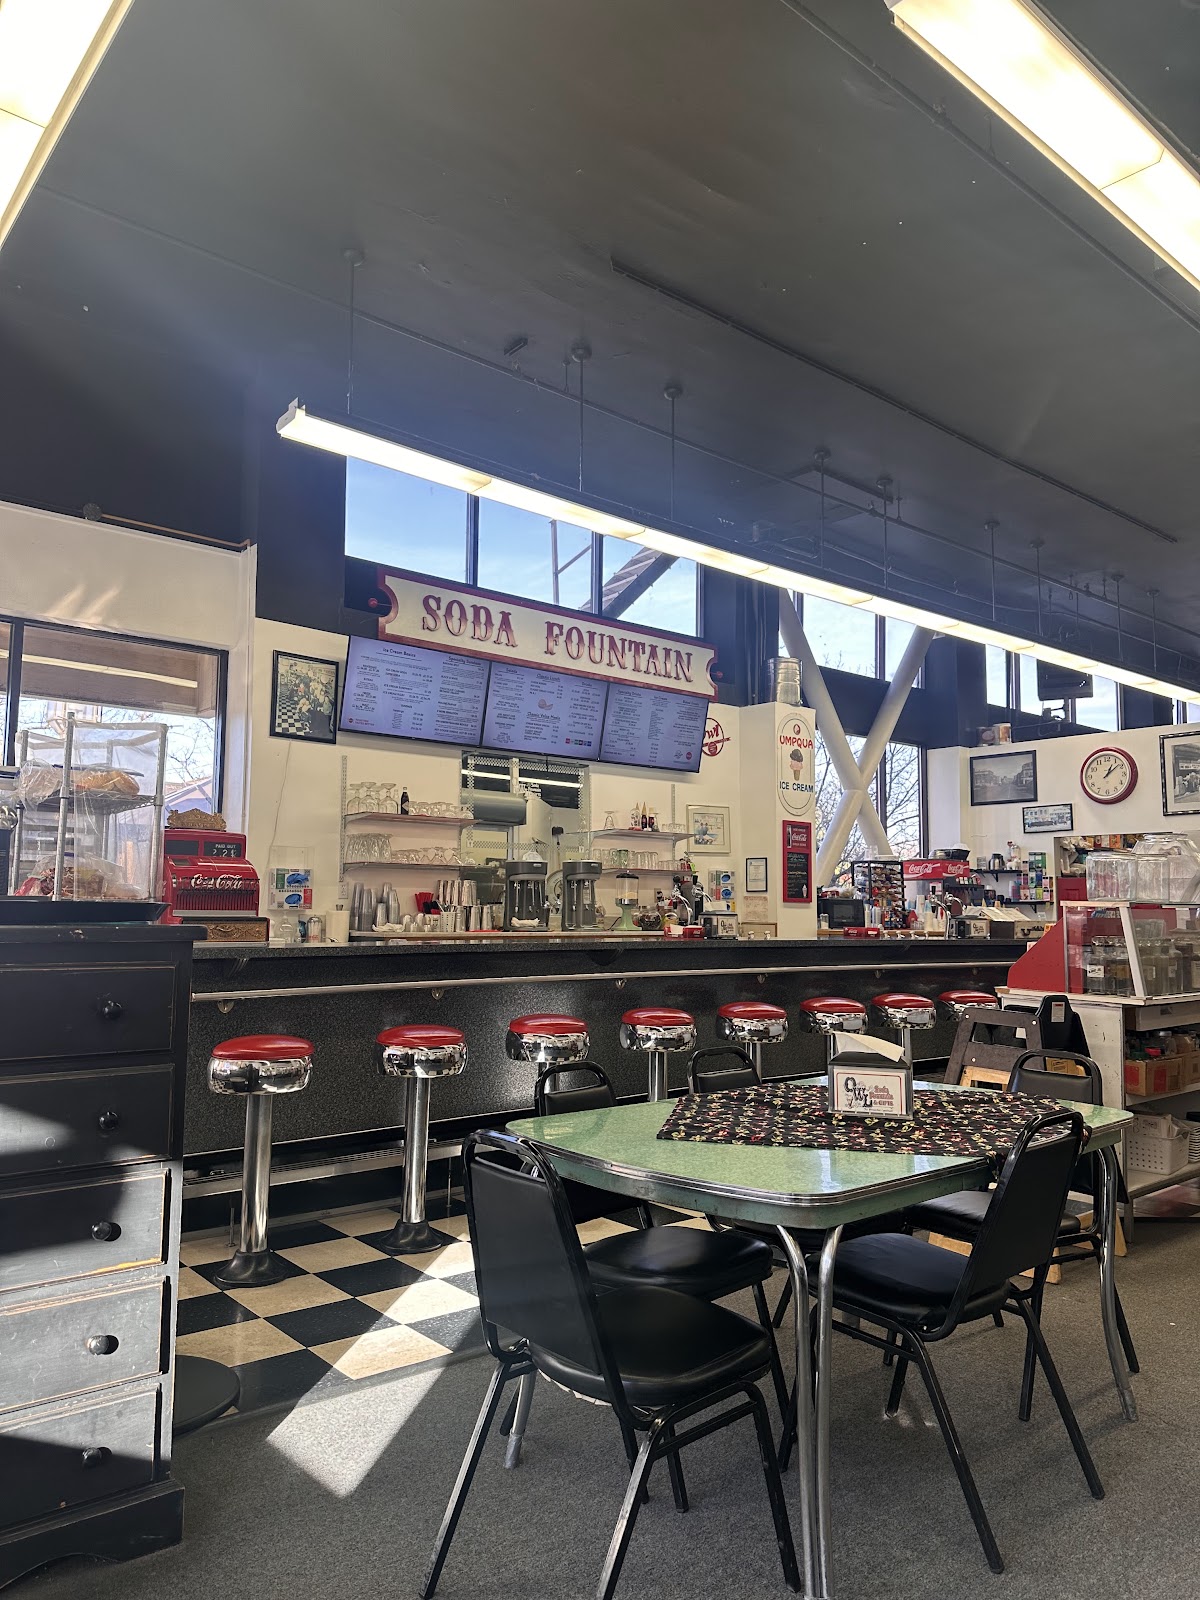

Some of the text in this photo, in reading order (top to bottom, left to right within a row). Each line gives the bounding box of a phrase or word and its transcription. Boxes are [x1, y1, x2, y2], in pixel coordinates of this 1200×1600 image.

[422, 594, 694, 683] SODA FOUNTAIN
[779, 735, 814, 750] UMPQUA
[779, 780, 814, 793] ICE CREAM
[908, 863, 935, 874] Coca-Cola
[947, 863, 965, 875] Coca-Cola
